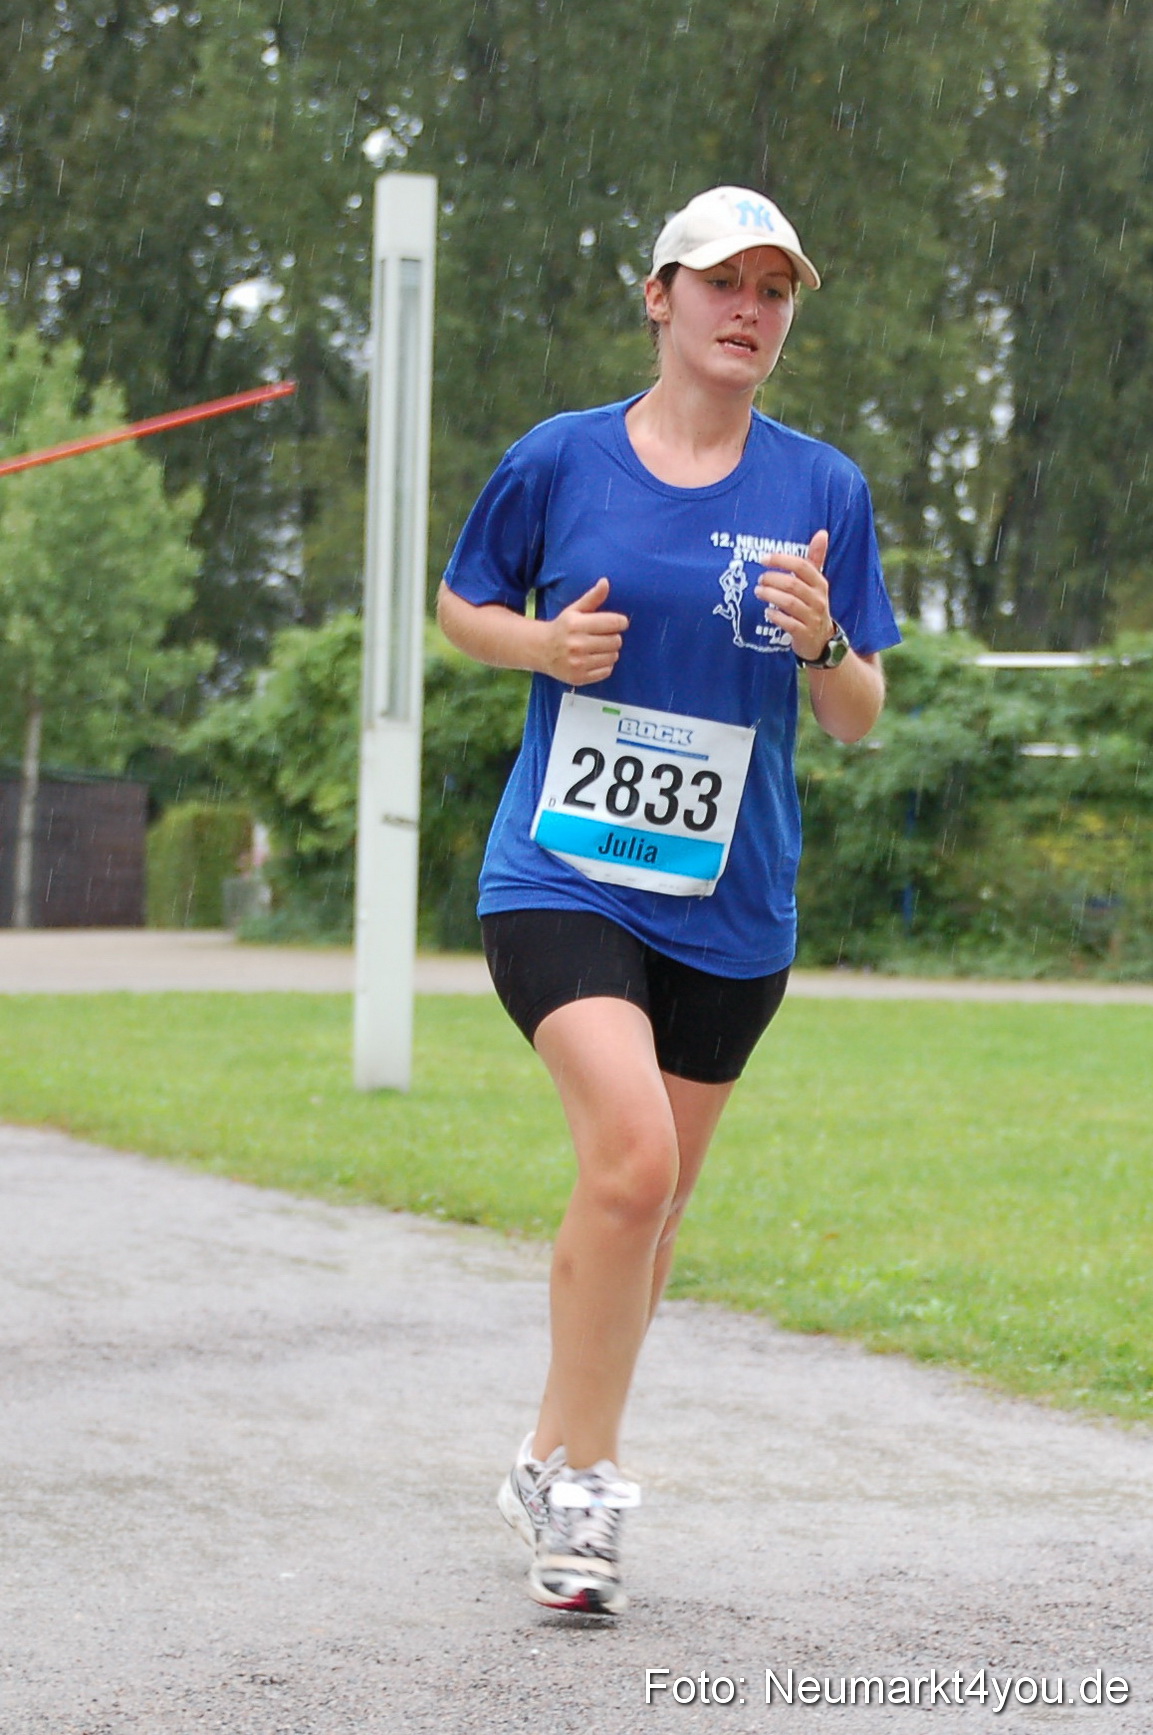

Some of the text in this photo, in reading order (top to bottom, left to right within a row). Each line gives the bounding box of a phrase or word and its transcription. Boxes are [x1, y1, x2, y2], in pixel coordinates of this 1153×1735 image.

[710, 531, 734, 548] 12.
[618, 717, 693, 746] BOCK
[562, 747, 723, 832] 2833
[597, 831, 659, 864] Julia
